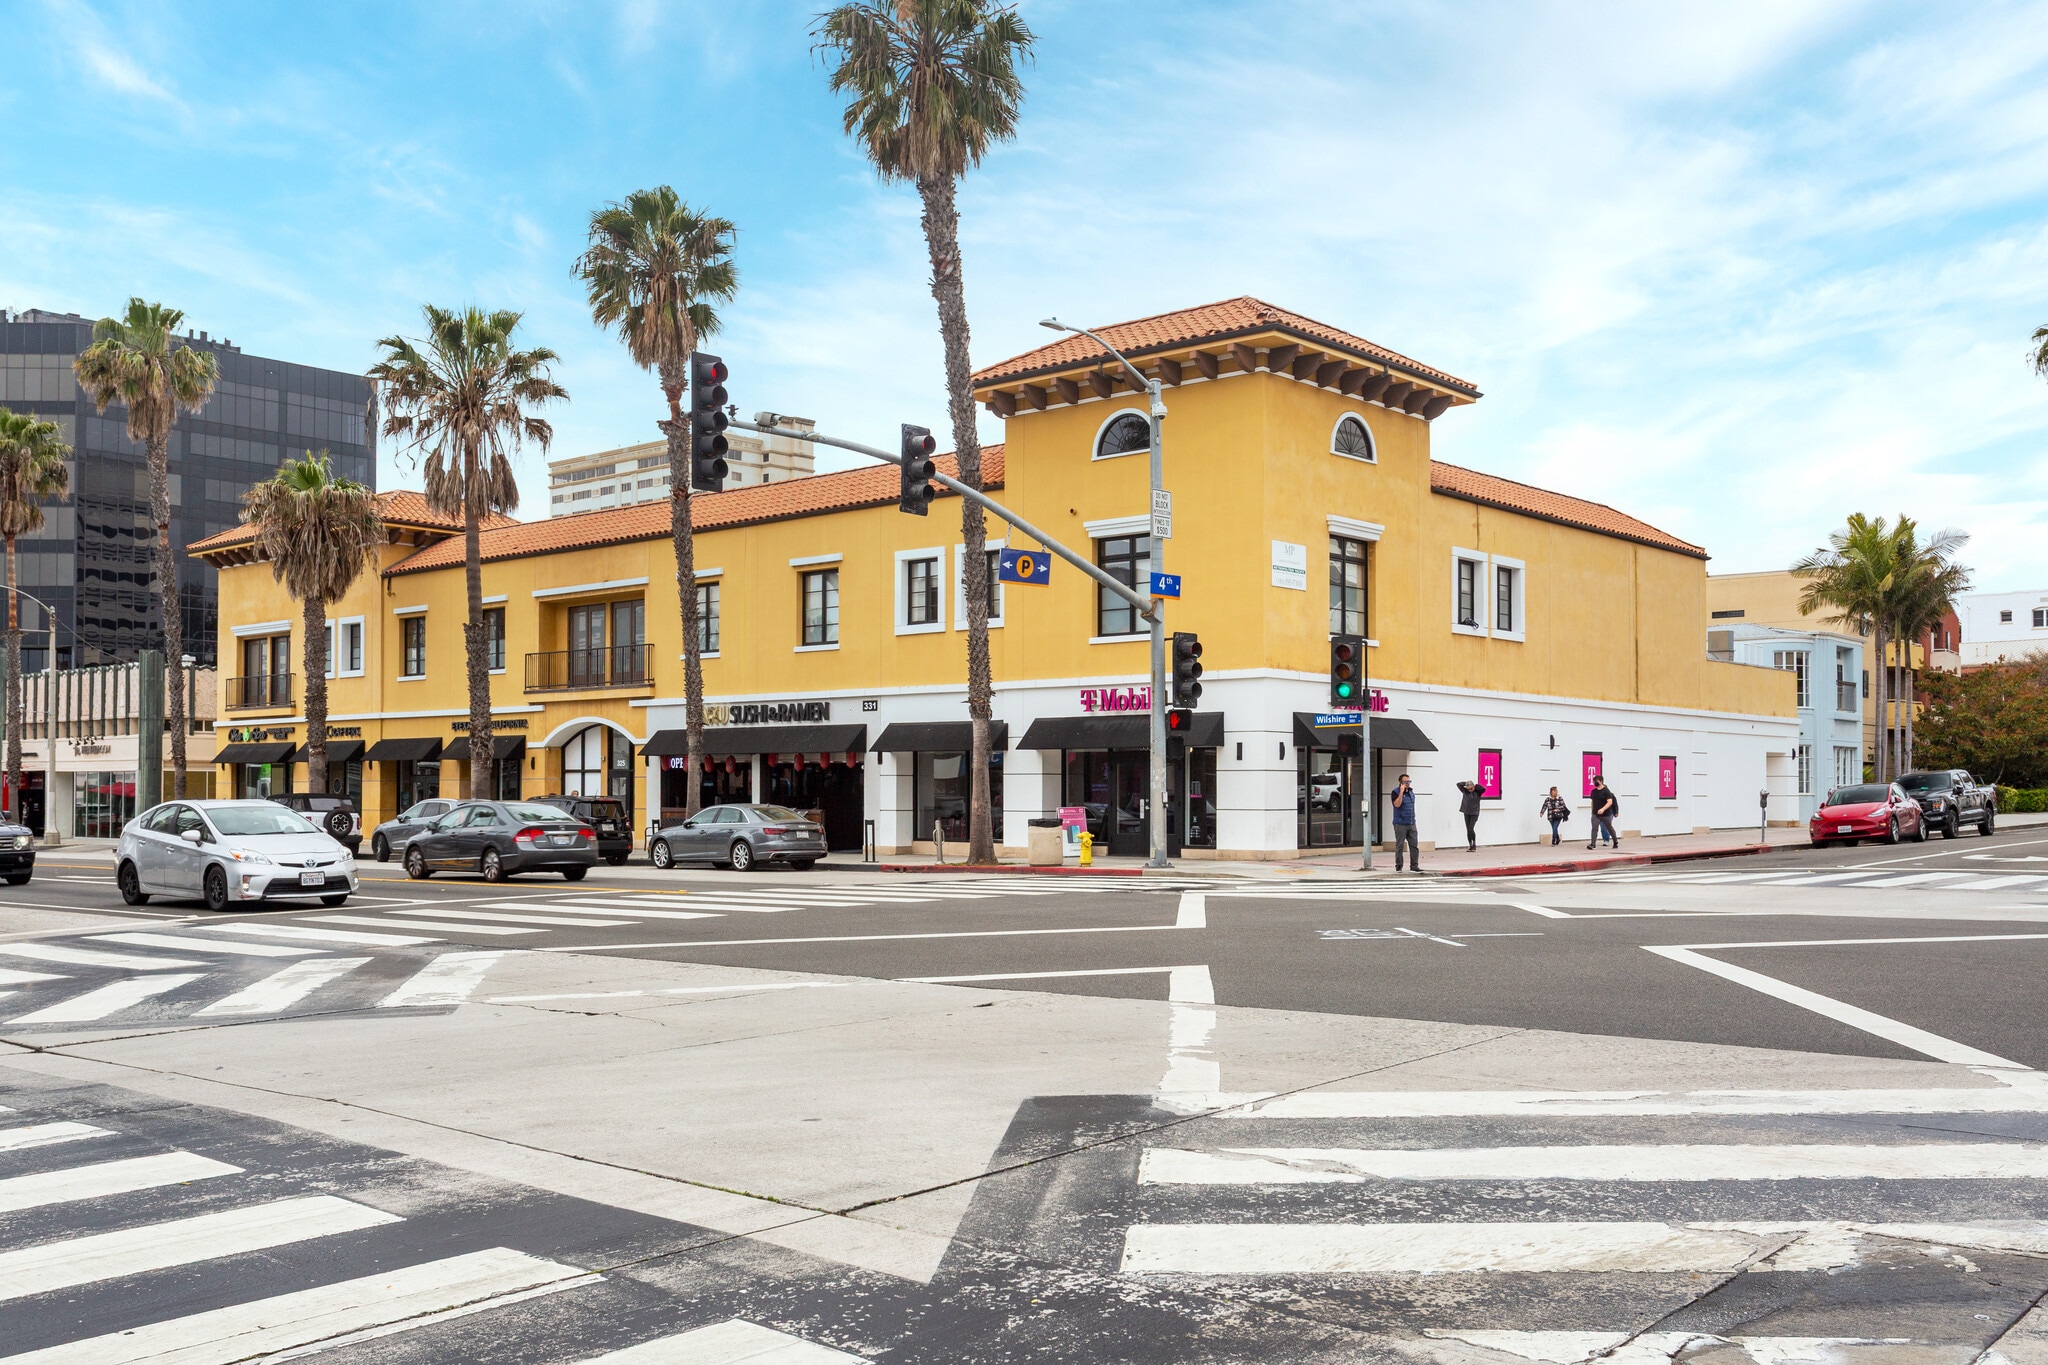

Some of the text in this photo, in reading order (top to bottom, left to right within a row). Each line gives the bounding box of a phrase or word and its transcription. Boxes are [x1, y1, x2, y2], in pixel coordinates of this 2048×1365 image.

[1155, 492, 1161, 500] DO
[1155, 499, 1169, 509] BLOCK
[1154, 518, 1170, 527] FINES TO
[1156, 526, 1169, 536] $500
[1021, 559, 1031, 574] P
[1159, 576, 1173, 590] 4th
[1099, 686, 1151, 711] Mobil
[864, 702, 877, 710] 331
[491, 719, 529, 730] ALIFORNIA
[1316, 715, 1346, 724] Wilshire
[617, 759, 626, 767] 325
[670, 757, 684, 769] OPE
